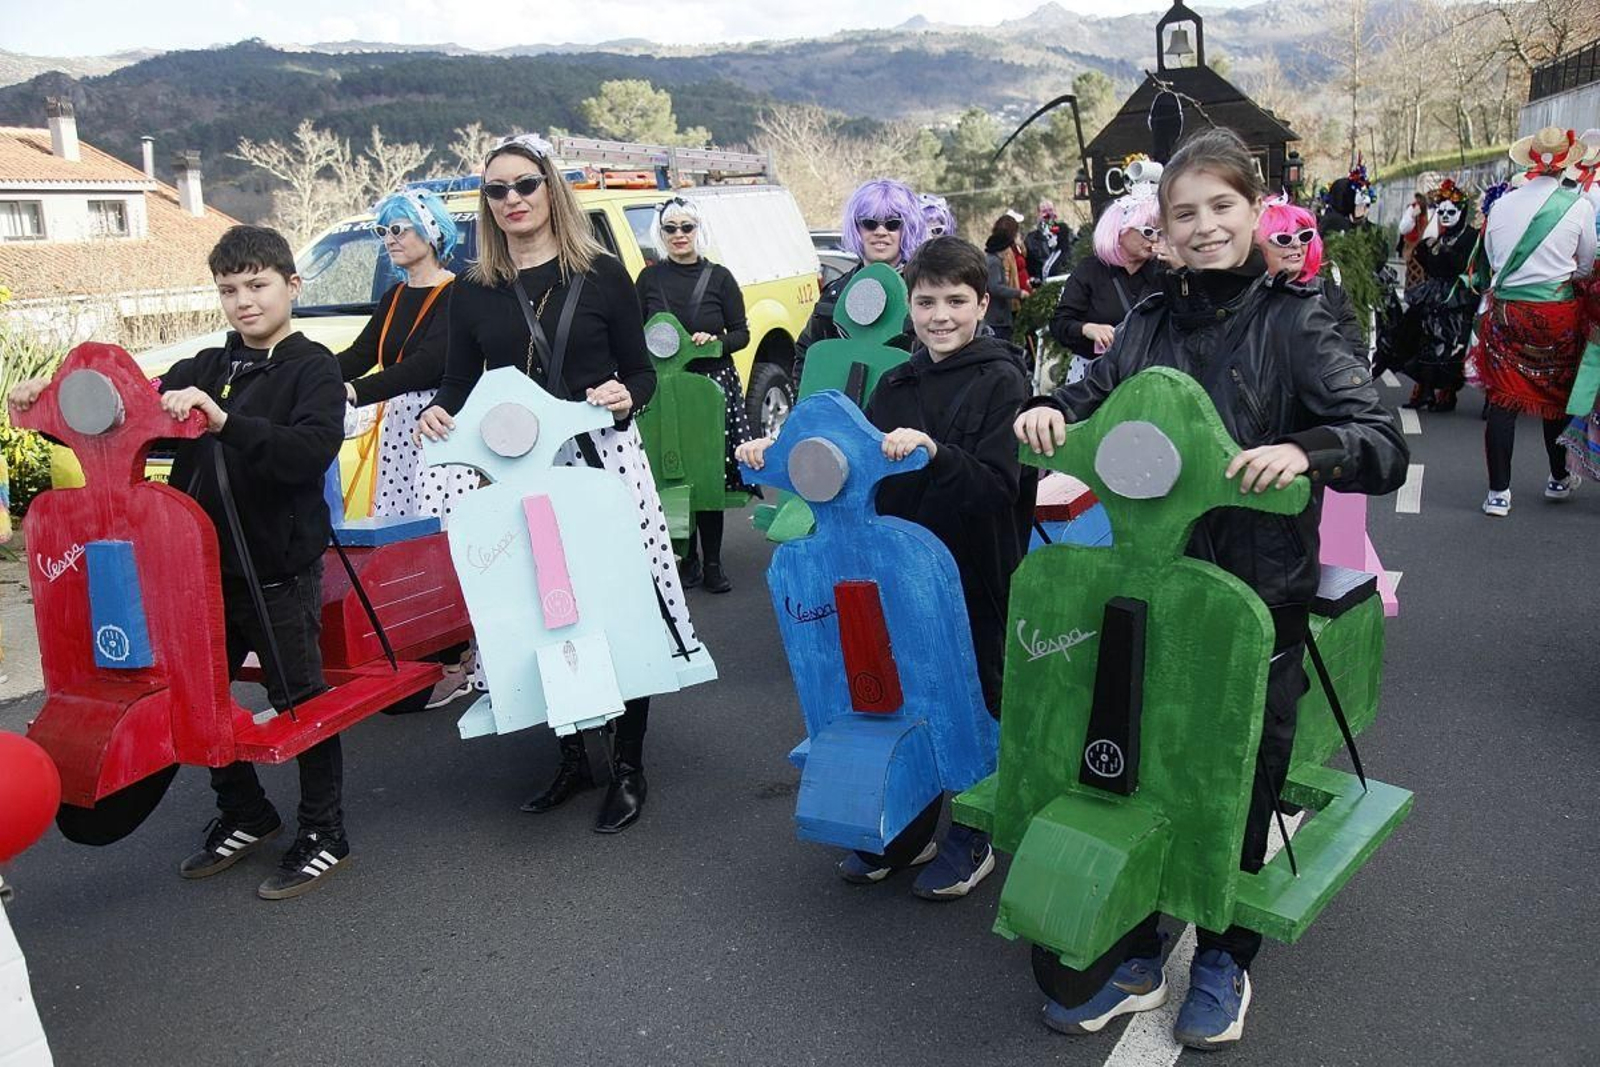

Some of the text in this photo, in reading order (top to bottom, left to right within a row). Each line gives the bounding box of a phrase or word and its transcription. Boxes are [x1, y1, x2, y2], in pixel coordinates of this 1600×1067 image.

[37, 543, 85, 582] Vespa
[467, 529, 521, 575] Vespa
[785, 596, 838, 629] Vespa
[1016, 619, 1097, 662] Vespa
